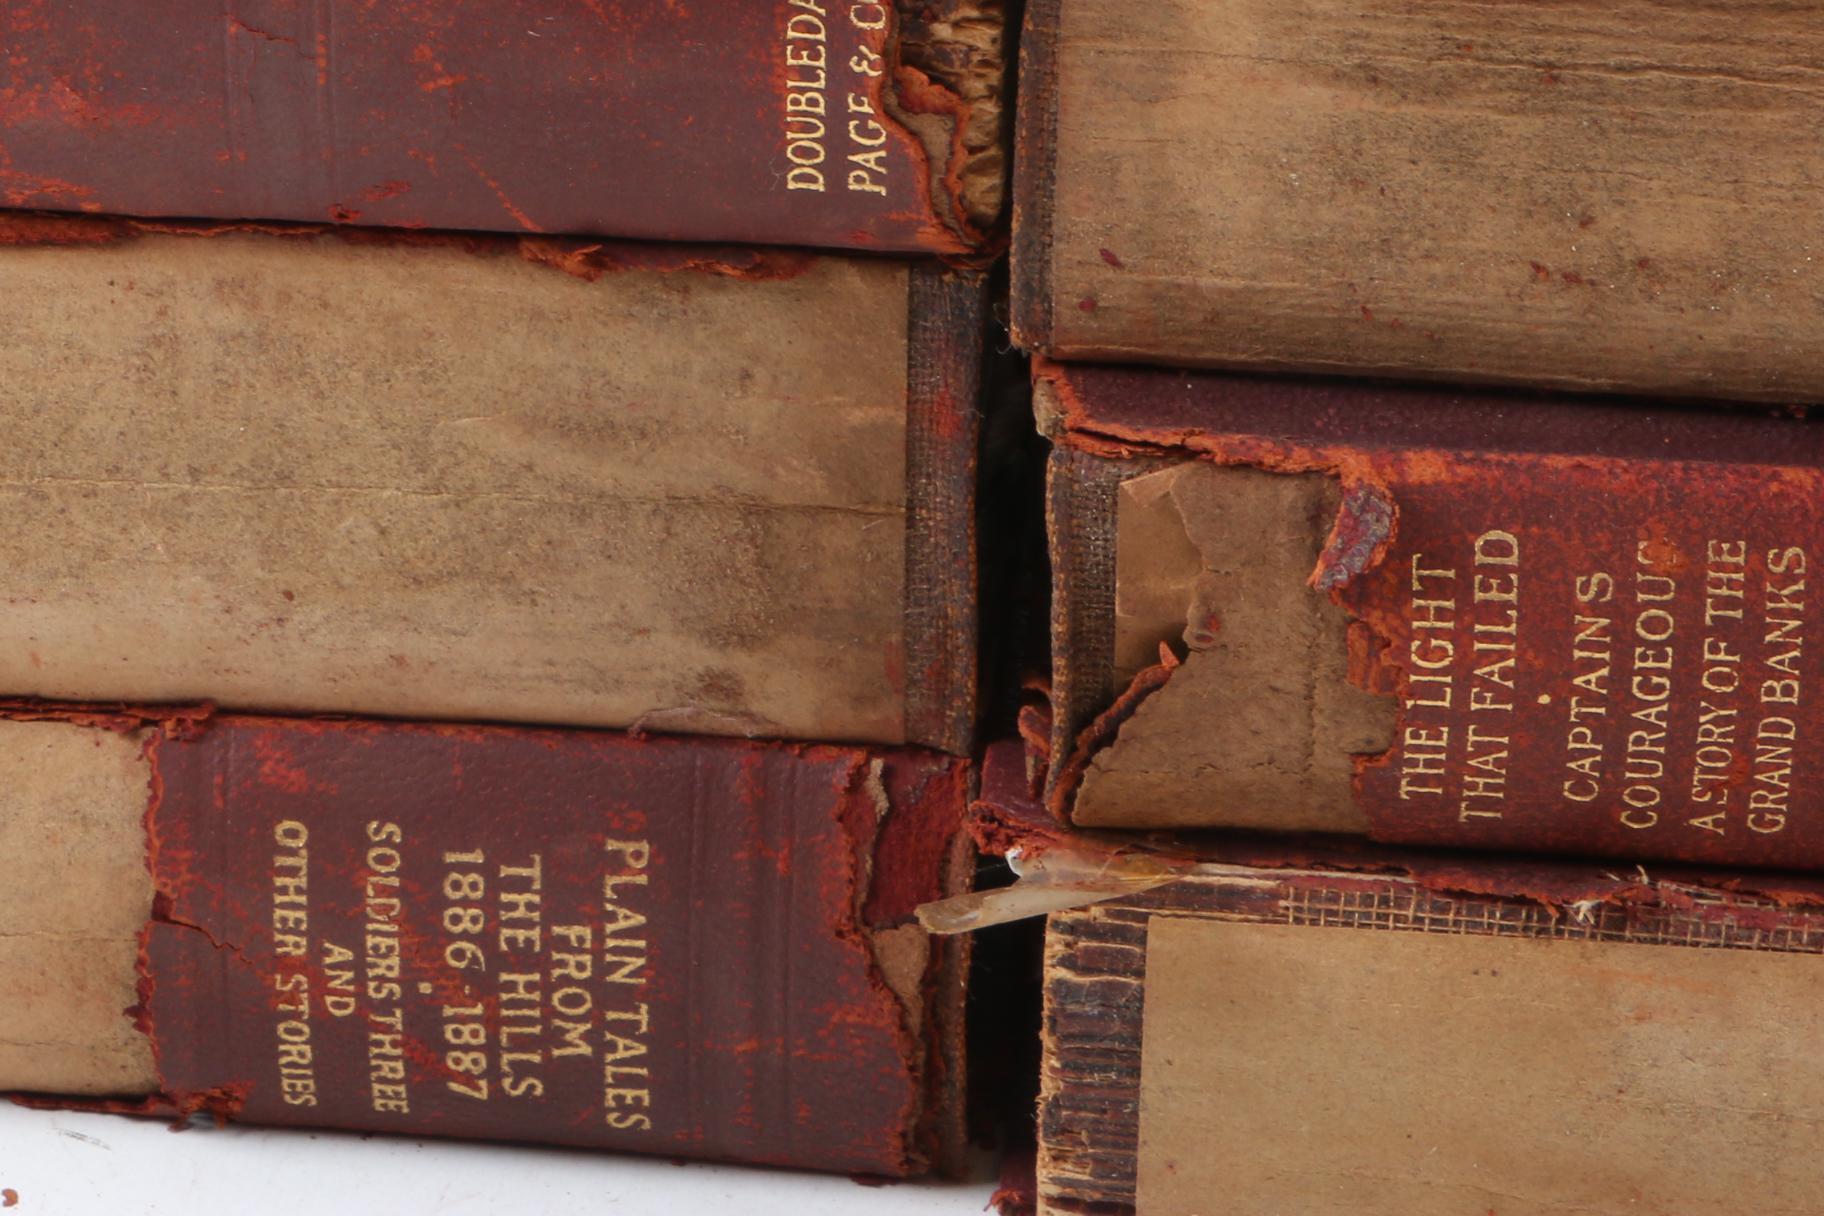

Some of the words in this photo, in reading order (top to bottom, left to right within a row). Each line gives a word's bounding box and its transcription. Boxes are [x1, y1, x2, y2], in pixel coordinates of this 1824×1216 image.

[849, 45, 882, 76] &
[847, 92, 887, 196] PAGE
[1405, 554, 1456, 709] LIGHT
[1471, 529, 1519, 711] FAILED
[1705, 539, 1747, 625] THE
[1760, 547, 1807, 705] BANKS
[1562, 571, 1613, 802] CAPTAINS
[1701, 638, 1742, 693] OF
[1399, 726, 1449, 800] THE
[1459, 724, 1510, 822] THAT
[1691, 701, 1740, 805] STORY
[1747, 717, 1796, 833] GRAND
[1685, 811, 1726, 836] A
[273, 820, 308, 955] OTHER
[365, 820, 402, 998] SOLDIERS
[499, 853, 542, 951] THE
[604, 839, 649, 984] PLAIN
[323, 942, 356, 1017] AND
[498, 972, 543, 1096] HILLS
[551, 924, 593, 1056] FROM
[274, 973, 317, 1107] STORIES
[369, 1009, 409, 1114] THREE
[603, 1002, 650, 1129] TALES
